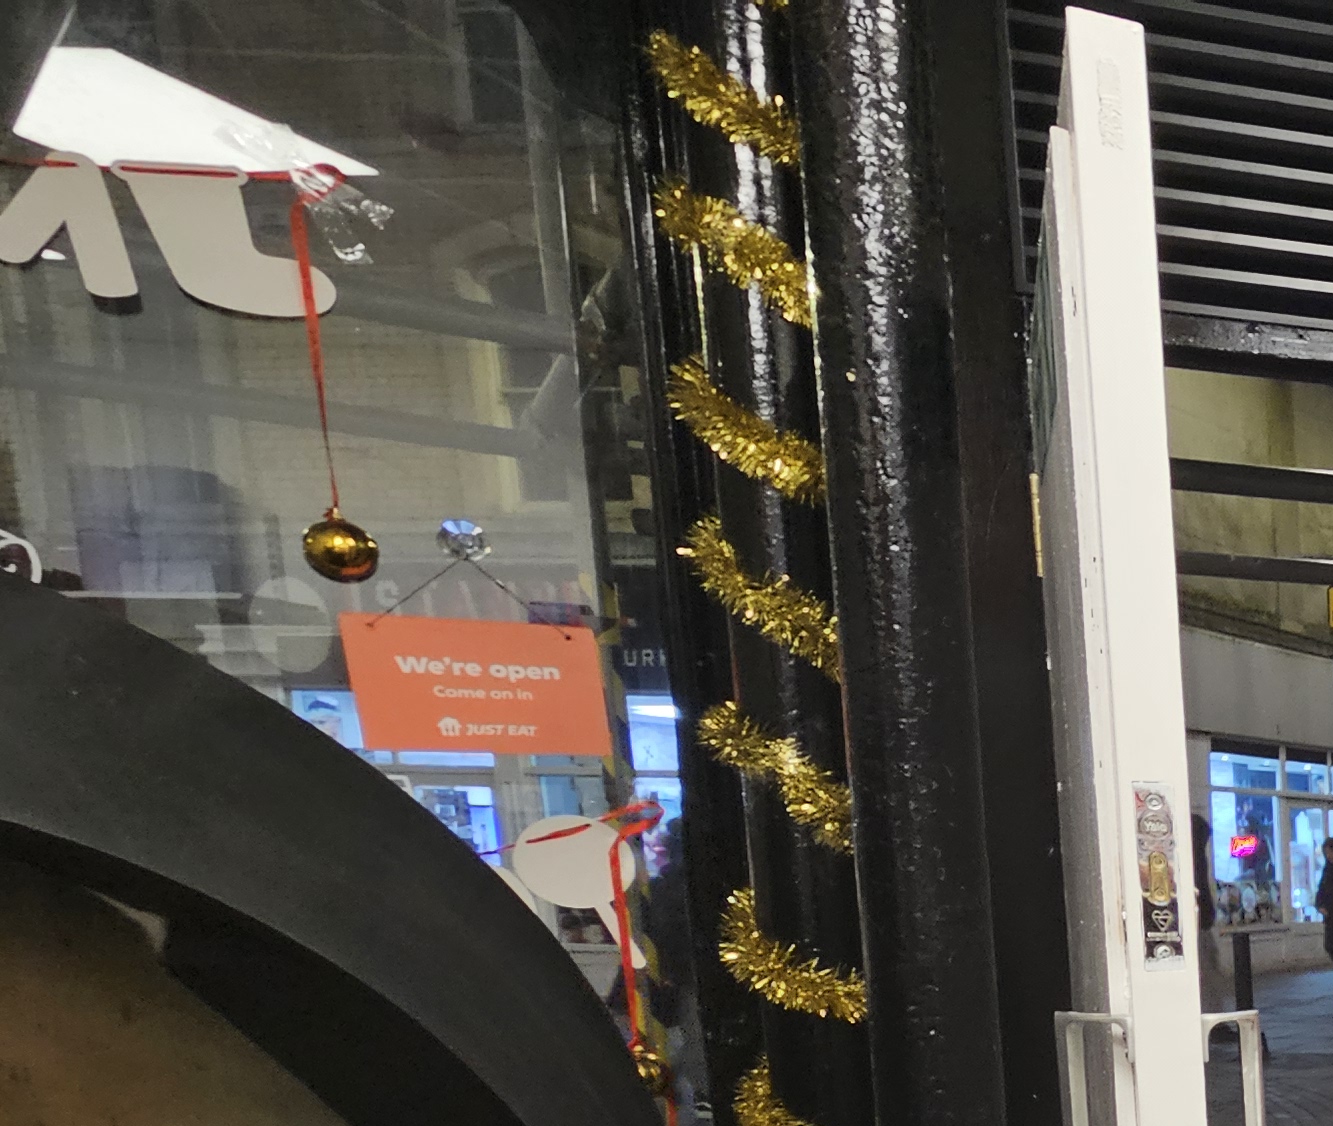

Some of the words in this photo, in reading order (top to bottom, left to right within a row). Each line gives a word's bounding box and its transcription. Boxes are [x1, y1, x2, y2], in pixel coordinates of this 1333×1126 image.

[394, 655, 482, 676] We're
[489, 662, 561, 683] open
[433, 684, 486, 701] Come
[489, 688, 513, 701] on
[516, 688, 533, 702] in
[466, 723, 504, 737] JUST
[507, 724, 538, 738] EAT
